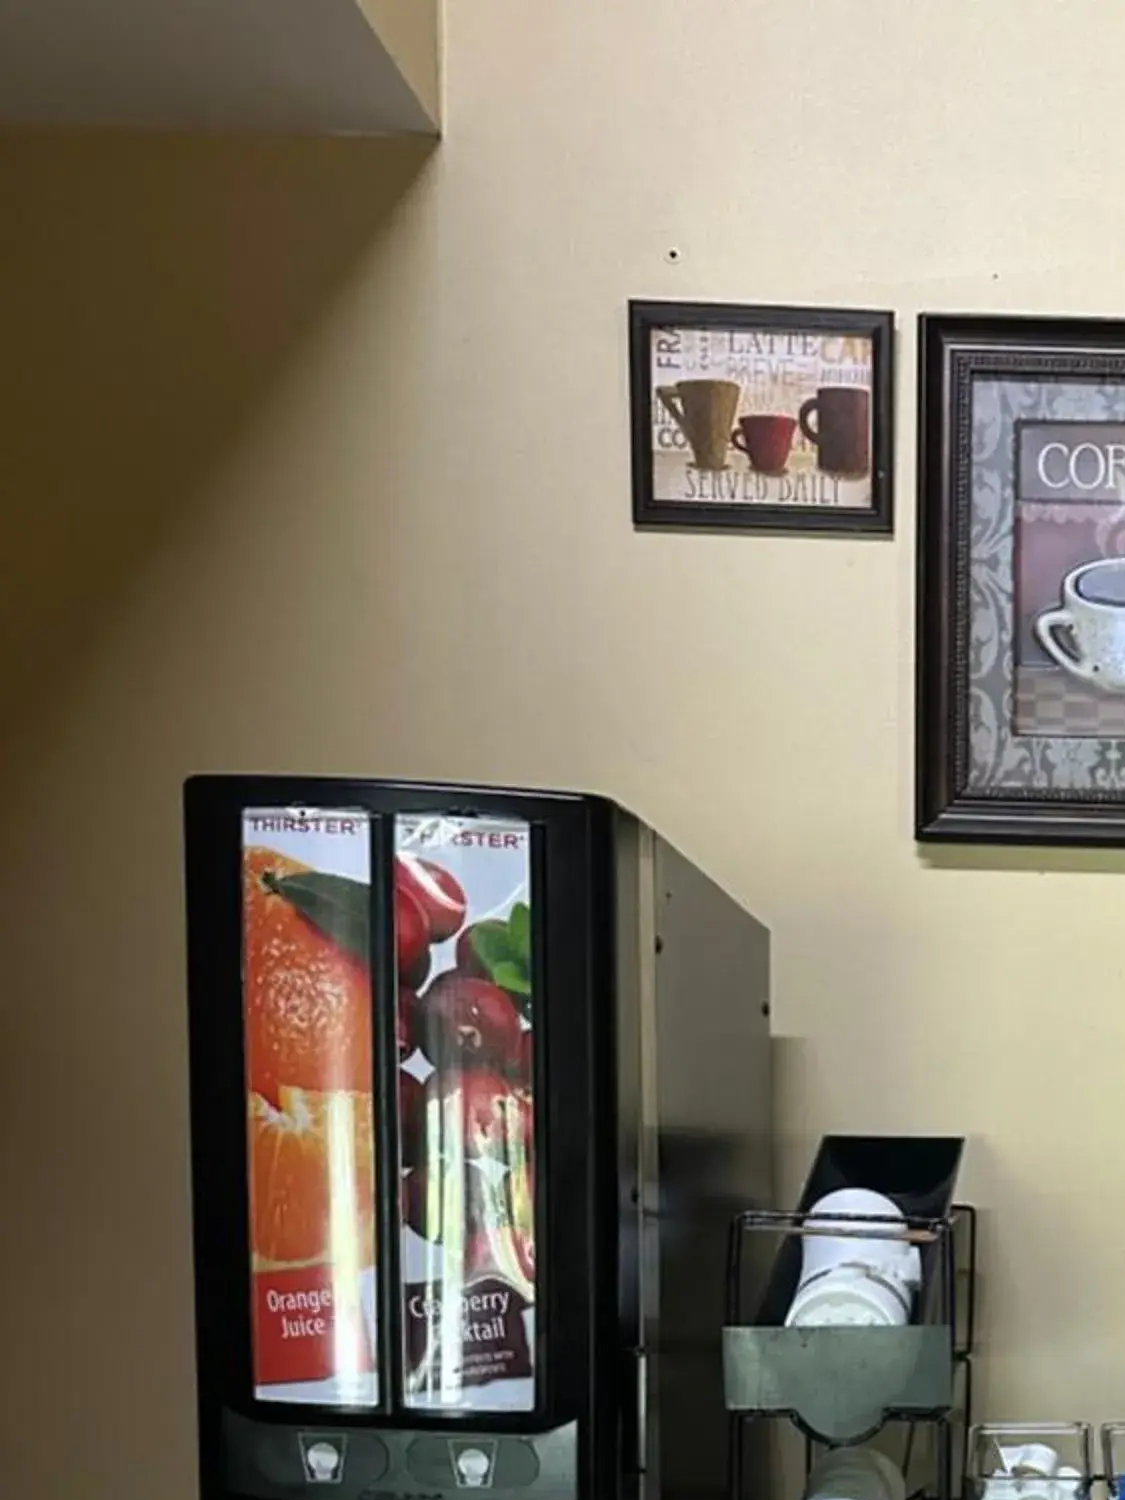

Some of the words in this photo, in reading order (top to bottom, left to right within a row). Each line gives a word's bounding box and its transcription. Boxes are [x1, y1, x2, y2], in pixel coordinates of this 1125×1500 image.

[727, 330, 819, 357] LATTE
[684, 470, 768, 501] SERVED
[778, 474, 842, 504] DAILY
[250, 817, 356, 836] THIRSTER
[266, 1288, 333, 1314] Orange
[280, 1315, 326, 1340] Juice
